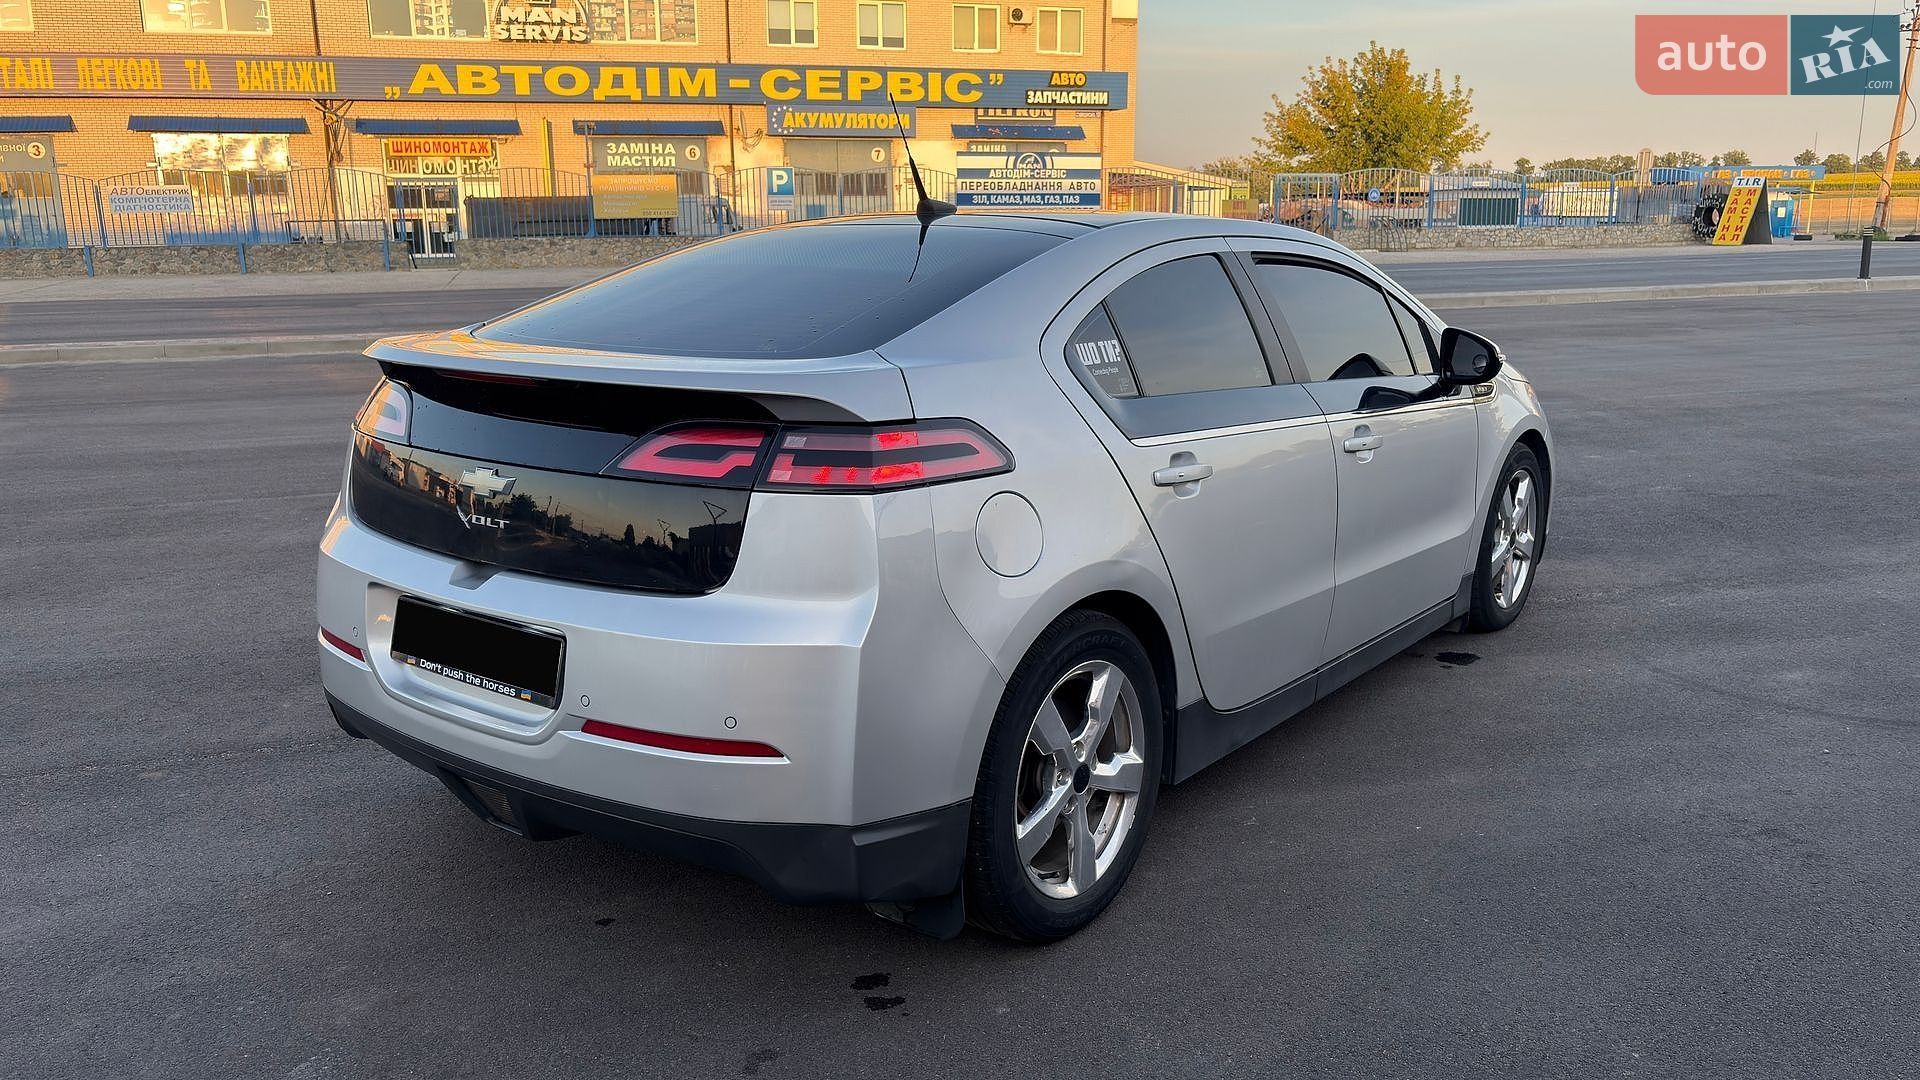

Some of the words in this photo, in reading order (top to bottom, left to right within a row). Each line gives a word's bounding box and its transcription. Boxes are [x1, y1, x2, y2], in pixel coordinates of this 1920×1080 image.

[501, 6, 578, 24] MAN
[494, 24, 590, 42] SERVIS
[77, 57, 163, 91] ЛЕГКОВІ
[185, 59, 213, 92] ТА
[235, 60, 337, 93] ВАНТАЖНІ
[1050, 72, 1087, 87] АВТО
[1026, 90, 1109, 105] ЗАПЧАСТИНИ
[782, 111, 911, 130] АКУМУЛЯТОРИ
[32, 144, 42, 157] 3
[391, 140, 490, 154] ШИНОМОНТАЖ
[606, 142, 677, 155] ЗАМІНА
[689, 146, 697, 159] 6
[607, 155, 677, 168] МАСТИЛ
[874, 149, 882, 161] 7
[772, 169, 789, 193] P
[989, 169, 1067, 179] АВТОДІМ-СЕРВІС
[110, 187, 190, 196] АВТОЕЛЕКТРИК
[961, 181, 1063, 192] ПЕРЕОБЛАДНАННЯ
[1069, 181, 1096, 191] АВТО
[990, 195, 1023, 205] КАМАЗ,
[1023, 195, 1044, 205] МАЗ,
[1044, 195, 1062, 205] ГАЗ,
[1062, 195, 1080, 205] ПАЗ
[114, 204, 191, 212] ДІАГНОСТИКА
[1718, 188, 1742, 241] ЗАМІНА
[1730, 188, 1758, 242] МАСТИЛ
[456, 505, 510, 530] VOLT
[419, 658, 442, 674] Don't
[442, 666, 464, 681] push
[465, 673, 481, 686] the
[482, 678, 516, 697] horses
